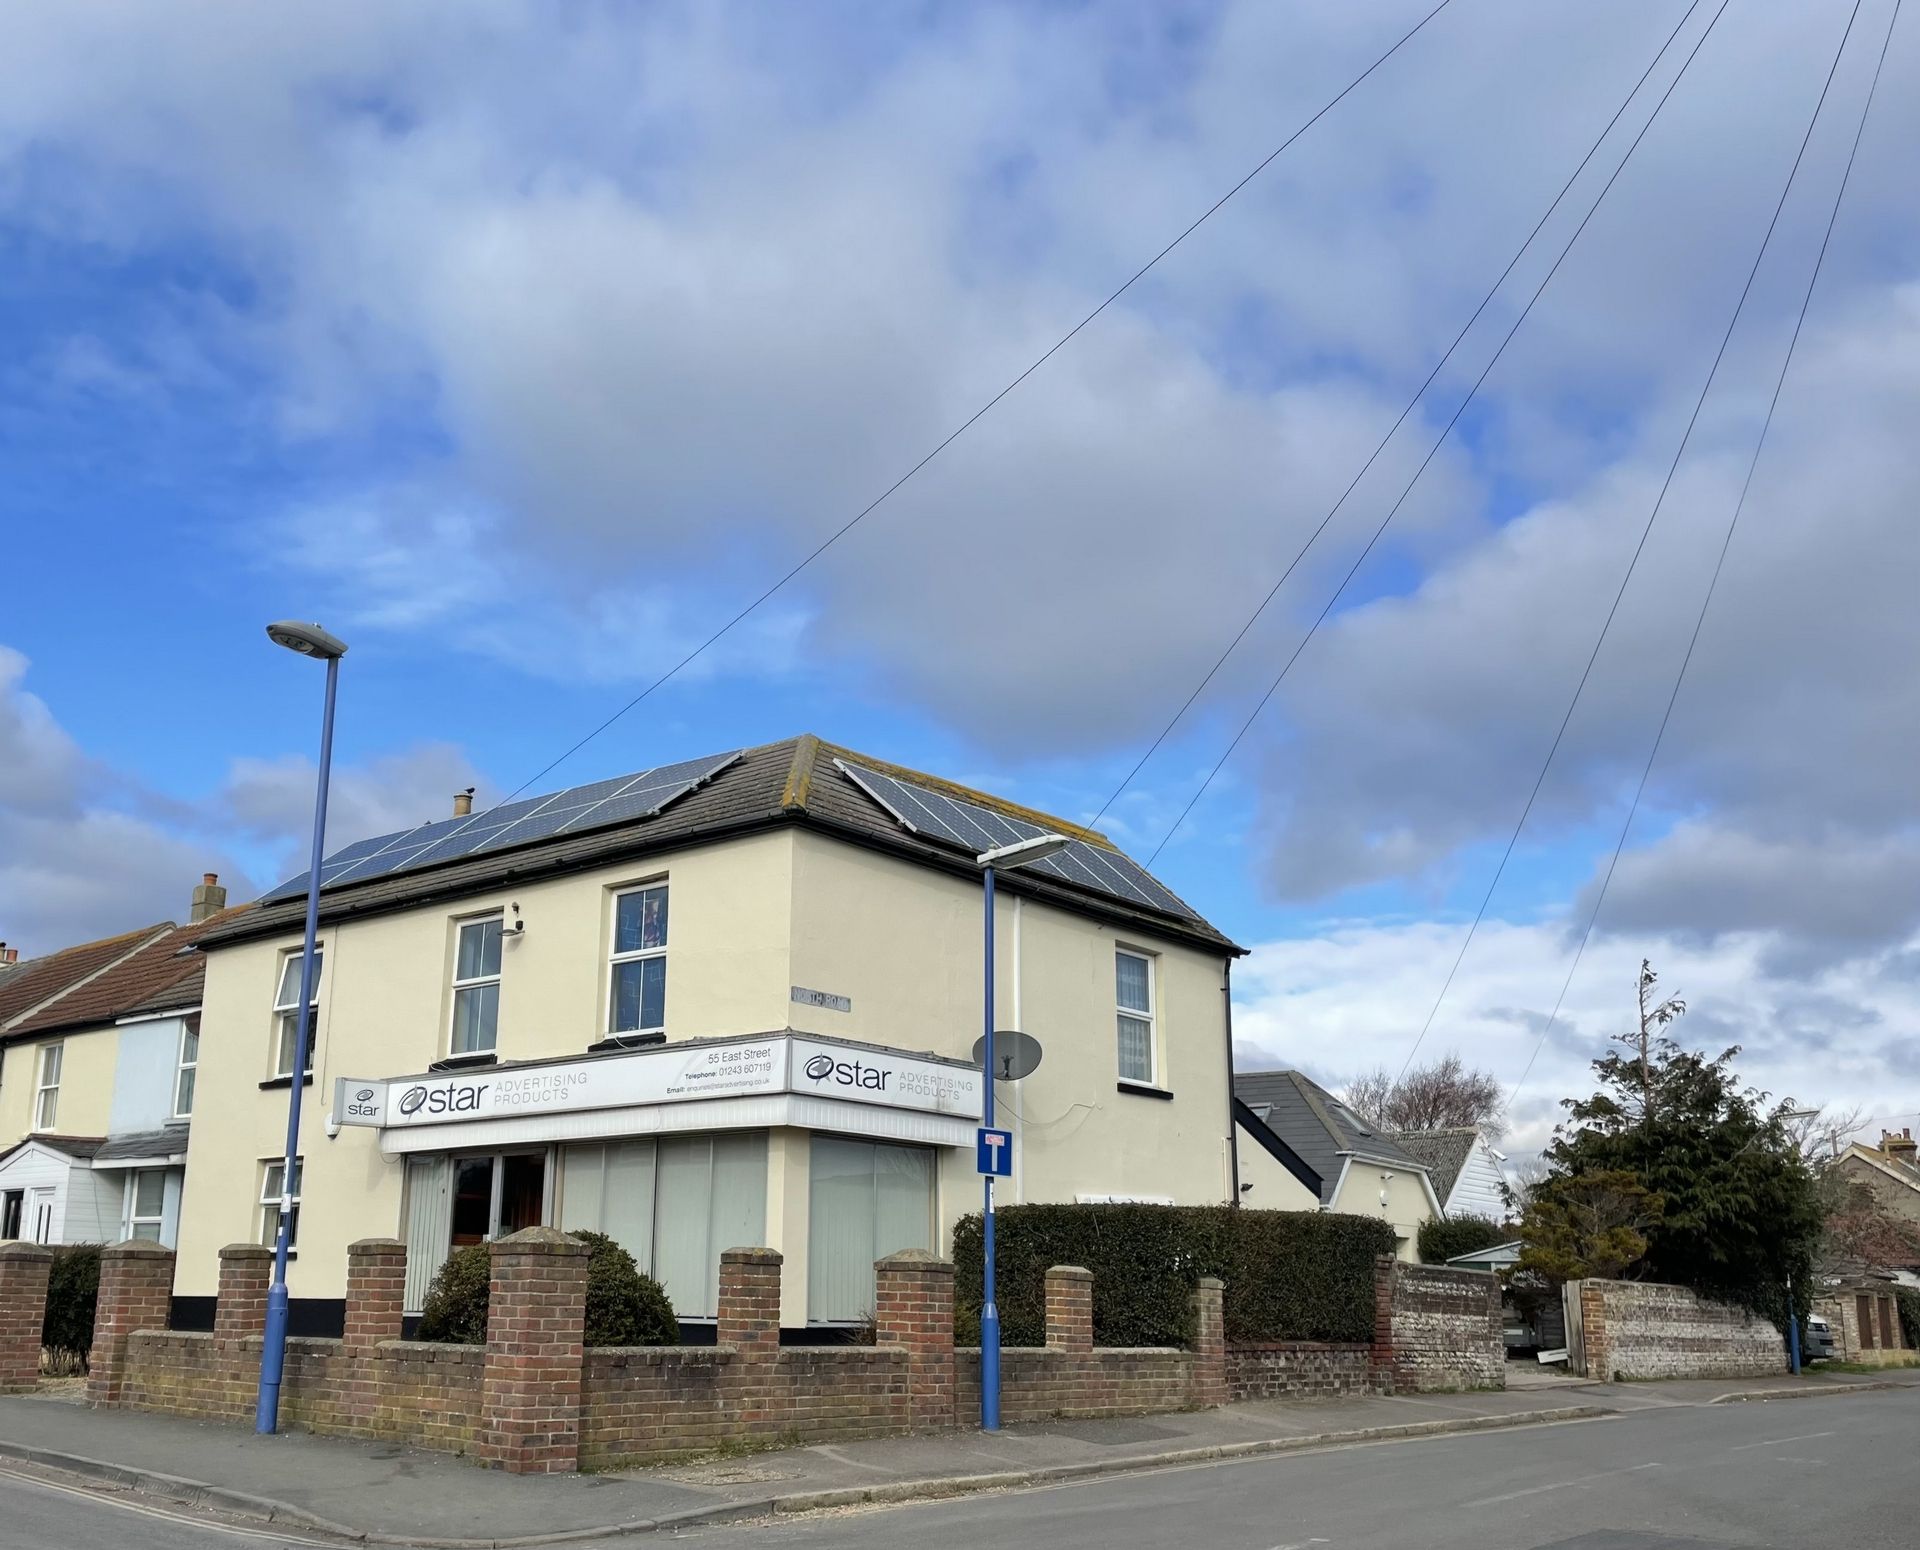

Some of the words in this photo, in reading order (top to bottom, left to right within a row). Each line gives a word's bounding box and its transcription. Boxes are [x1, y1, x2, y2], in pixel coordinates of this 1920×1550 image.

[708, 1054, 720, 1064] 55
[722, 1051, 742, 1063] East
[744, 1048, 771, 1060] Street
[685, 1071, 717, 1080] Telephone:
[719, 1065, 742, 1076] 01243
[744, 1062, 771, 1074] 607119
[836, 1060, 892, 1091] star
[495, 1072, 588, 1092] ADVERTISING
[899, 1072, 973, 1092] ADVERTISING
[899, 1082, 960, 1101] PRODUCTS
[428, 1082, 489, 1114] star
[494, 1087, 569, 1106] PRODUCTS
[348, 1103, 380, 1117] star
